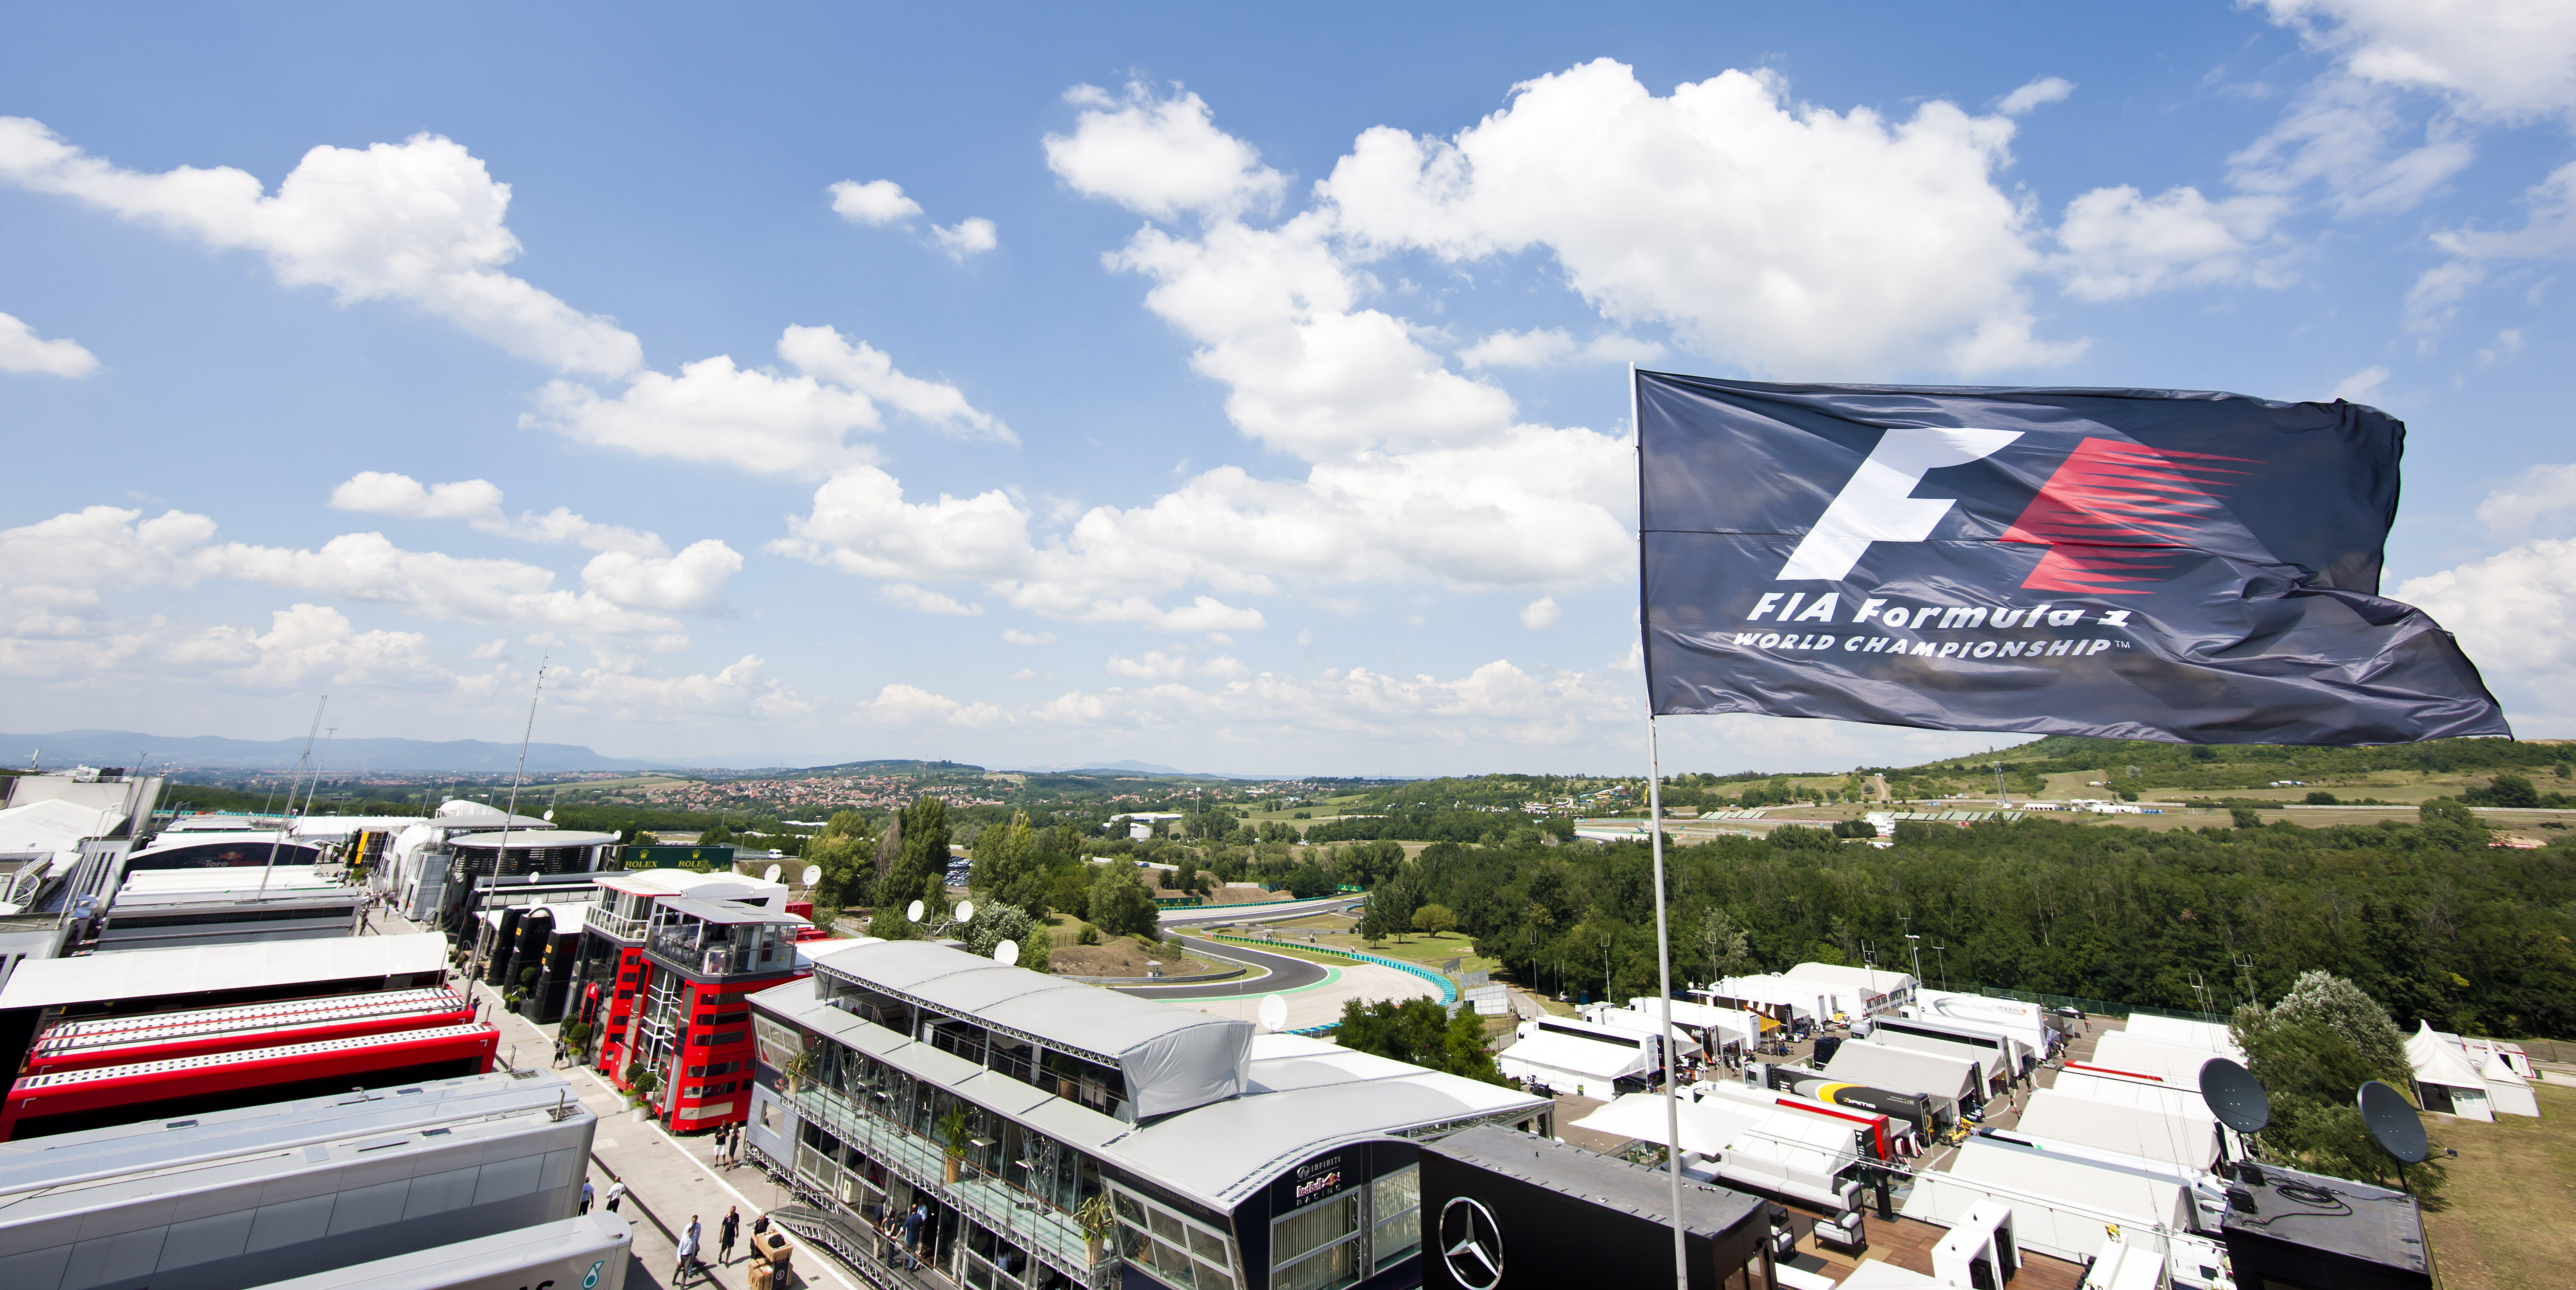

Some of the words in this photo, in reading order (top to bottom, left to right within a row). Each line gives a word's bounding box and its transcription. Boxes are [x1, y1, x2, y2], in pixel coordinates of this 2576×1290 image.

[1746, 592, 1840, 622] FIA
[1852, 598, 2085, 629] Formula
[2097, 610, 2132, 627] 1
[1733, 633, 1836, 650] WORLD
[1844, 636, 2111, 658] CHAMPIONSHIP
[1311, 1156, 1340, 1172] INFINITI
[1119, 1169, 1210, 1216] INFINITI-REDBULLRACING.COM
[1297, 1185, 1340, 1206] RACING
